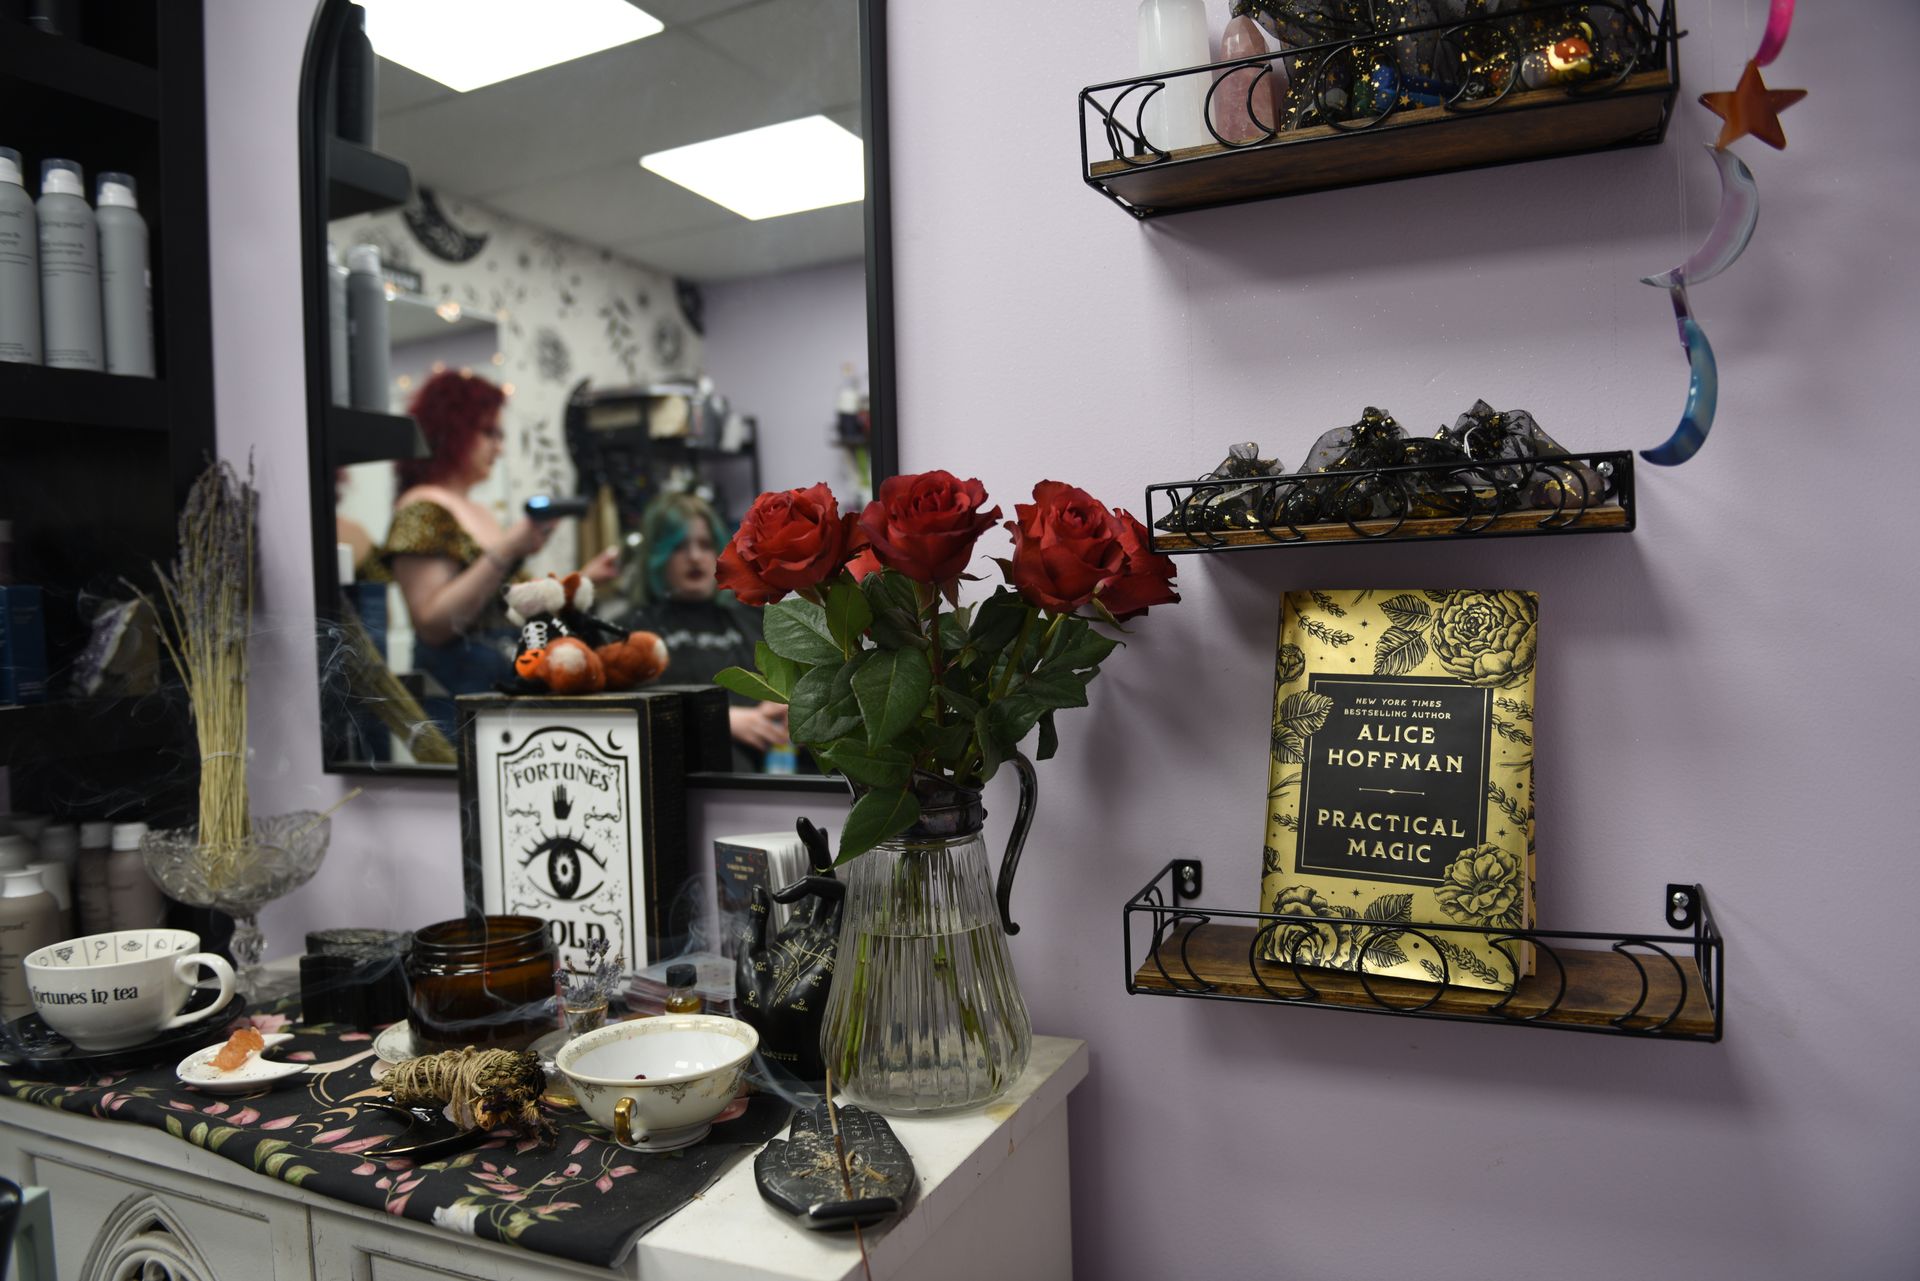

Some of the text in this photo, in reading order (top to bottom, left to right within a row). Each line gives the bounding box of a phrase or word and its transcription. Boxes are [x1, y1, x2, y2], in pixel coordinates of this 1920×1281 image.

[1343, 708, 1451, 720] BESTSELLING AUTHOR
[1355, 697, 1442, 708] NEW YORK TIMES
[1357, 724, 1435, 744] ALICE
[1327, 748, 1463, 773] HOFFMAN
[513, 762, 610, 792] FORTUNES
[1317, 808, 1466, 838] PRACTICAL
[1347, 838, 1432, 863] MAGIC
[549, 919, 606, 949] OLD
[91, 989, 108, 1004] in
[113, 986, 138, 1000] tea
